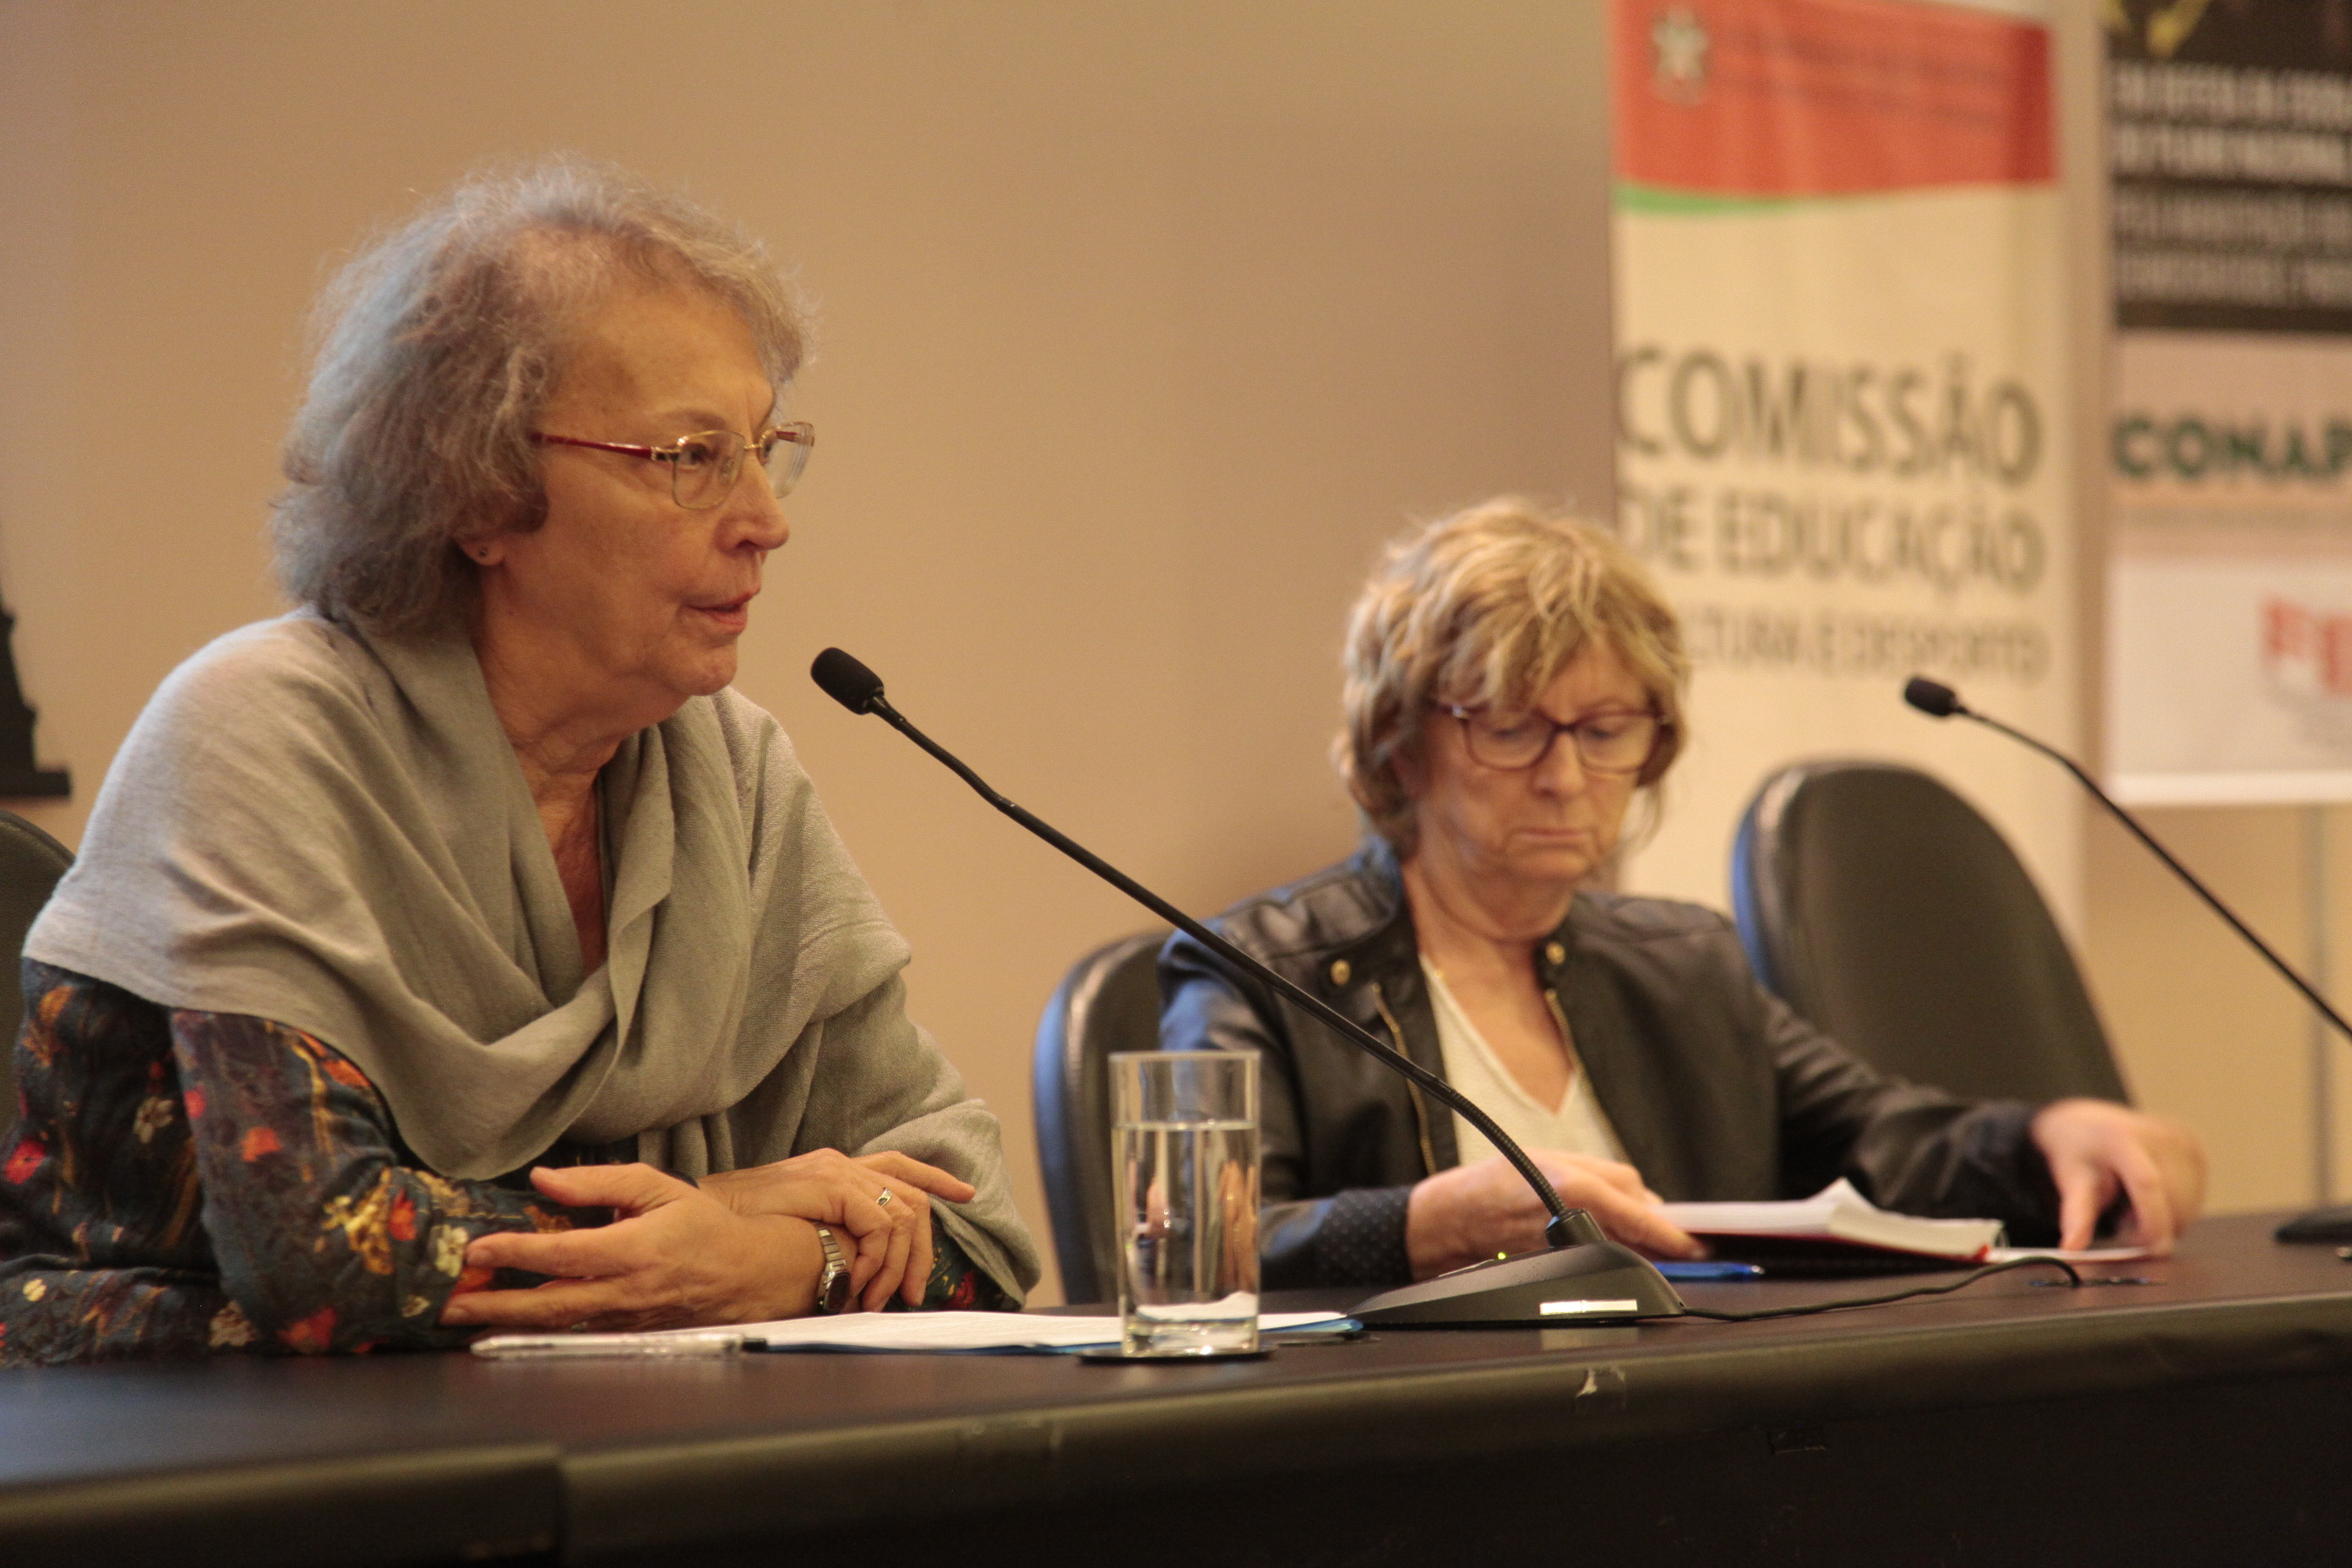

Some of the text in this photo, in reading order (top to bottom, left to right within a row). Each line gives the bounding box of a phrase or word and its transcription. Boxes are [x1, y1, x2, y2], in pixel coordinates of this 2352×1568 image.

[1614, 345, 2043, 488] COMISSÃO
[1614, 483, 2048, 603] DE EDUCAÇÃO
